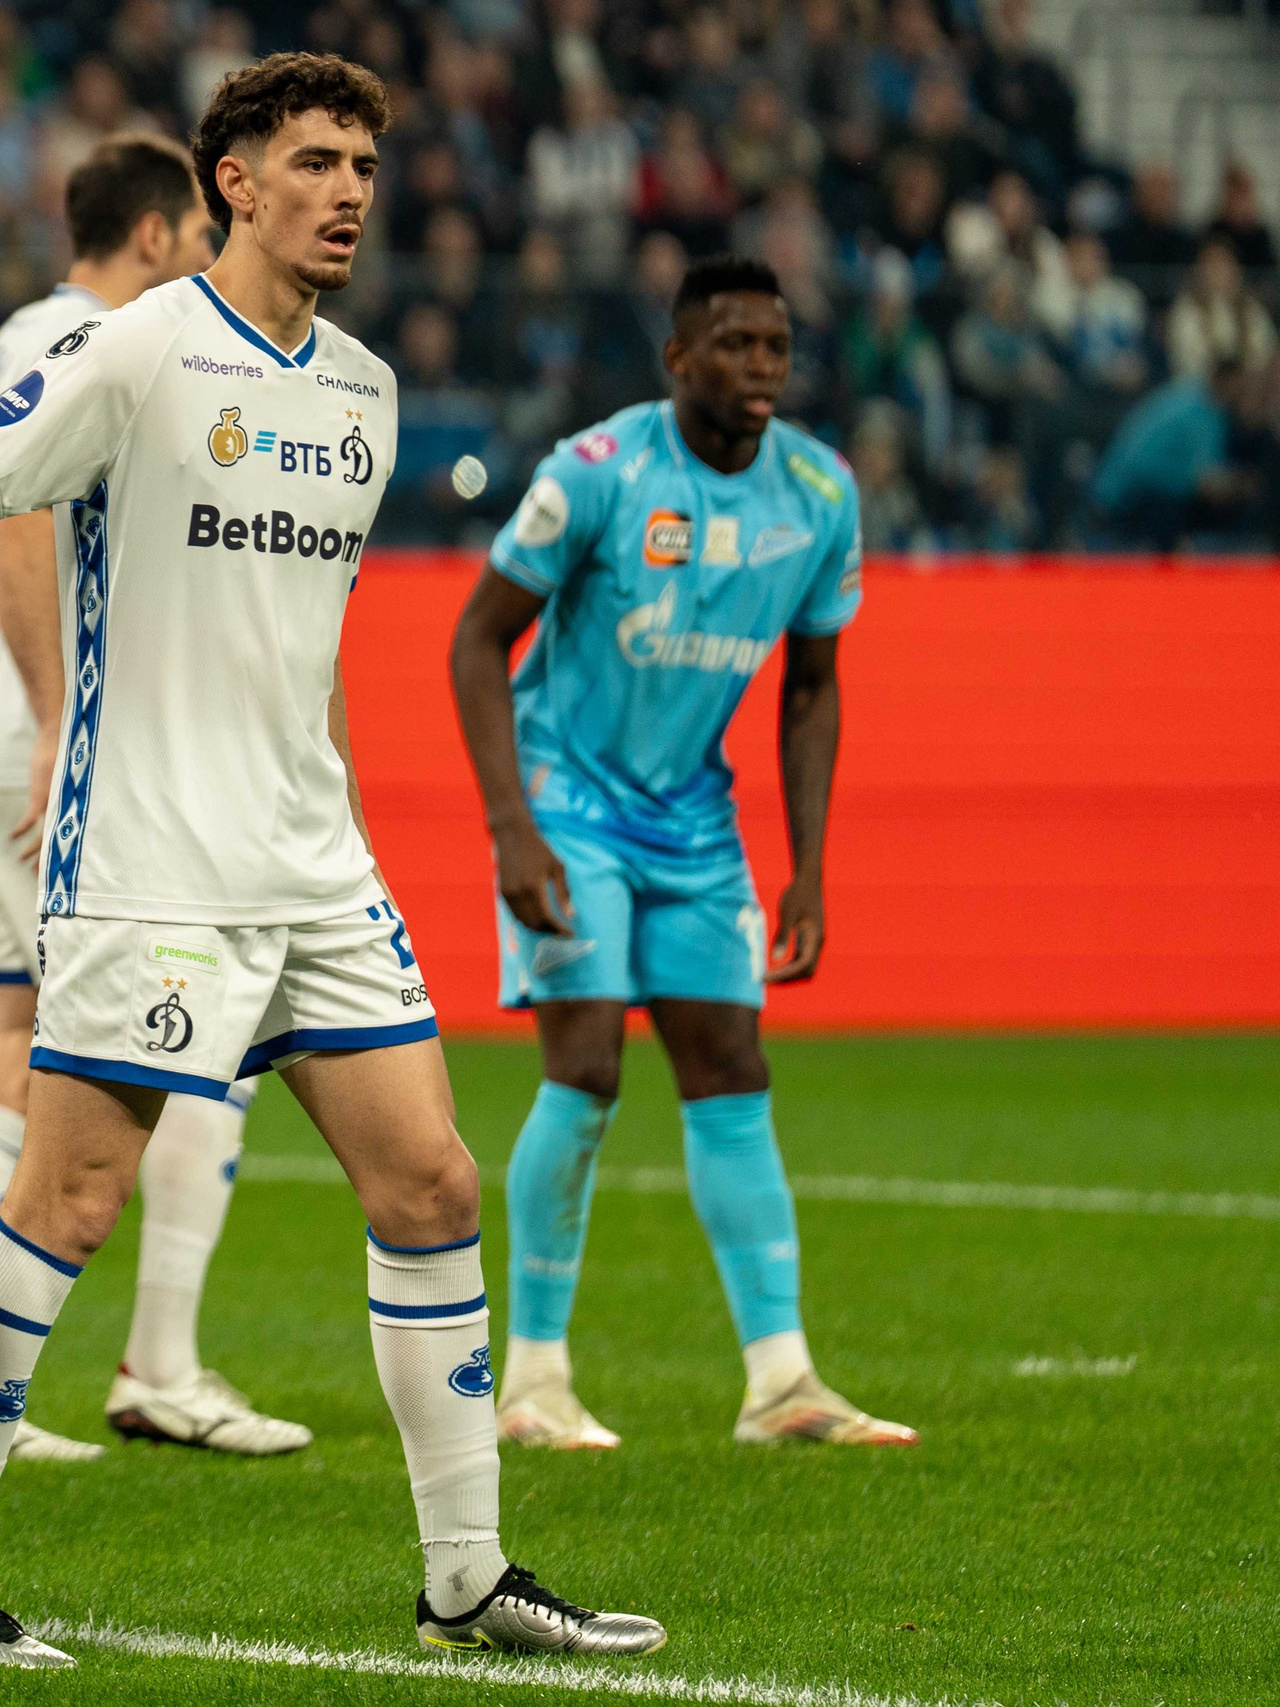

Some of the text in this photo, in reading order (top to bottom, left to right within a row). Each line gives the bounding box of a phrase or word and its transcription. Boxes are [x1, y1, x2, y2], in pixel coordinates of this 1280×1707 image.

[317, 374, 380, 399] CHANGAN
[280, 440, 332, 477] ВТБ
[187, 503, 363, 564] BetBoom
[154, 945, 218, 967] greenworks
